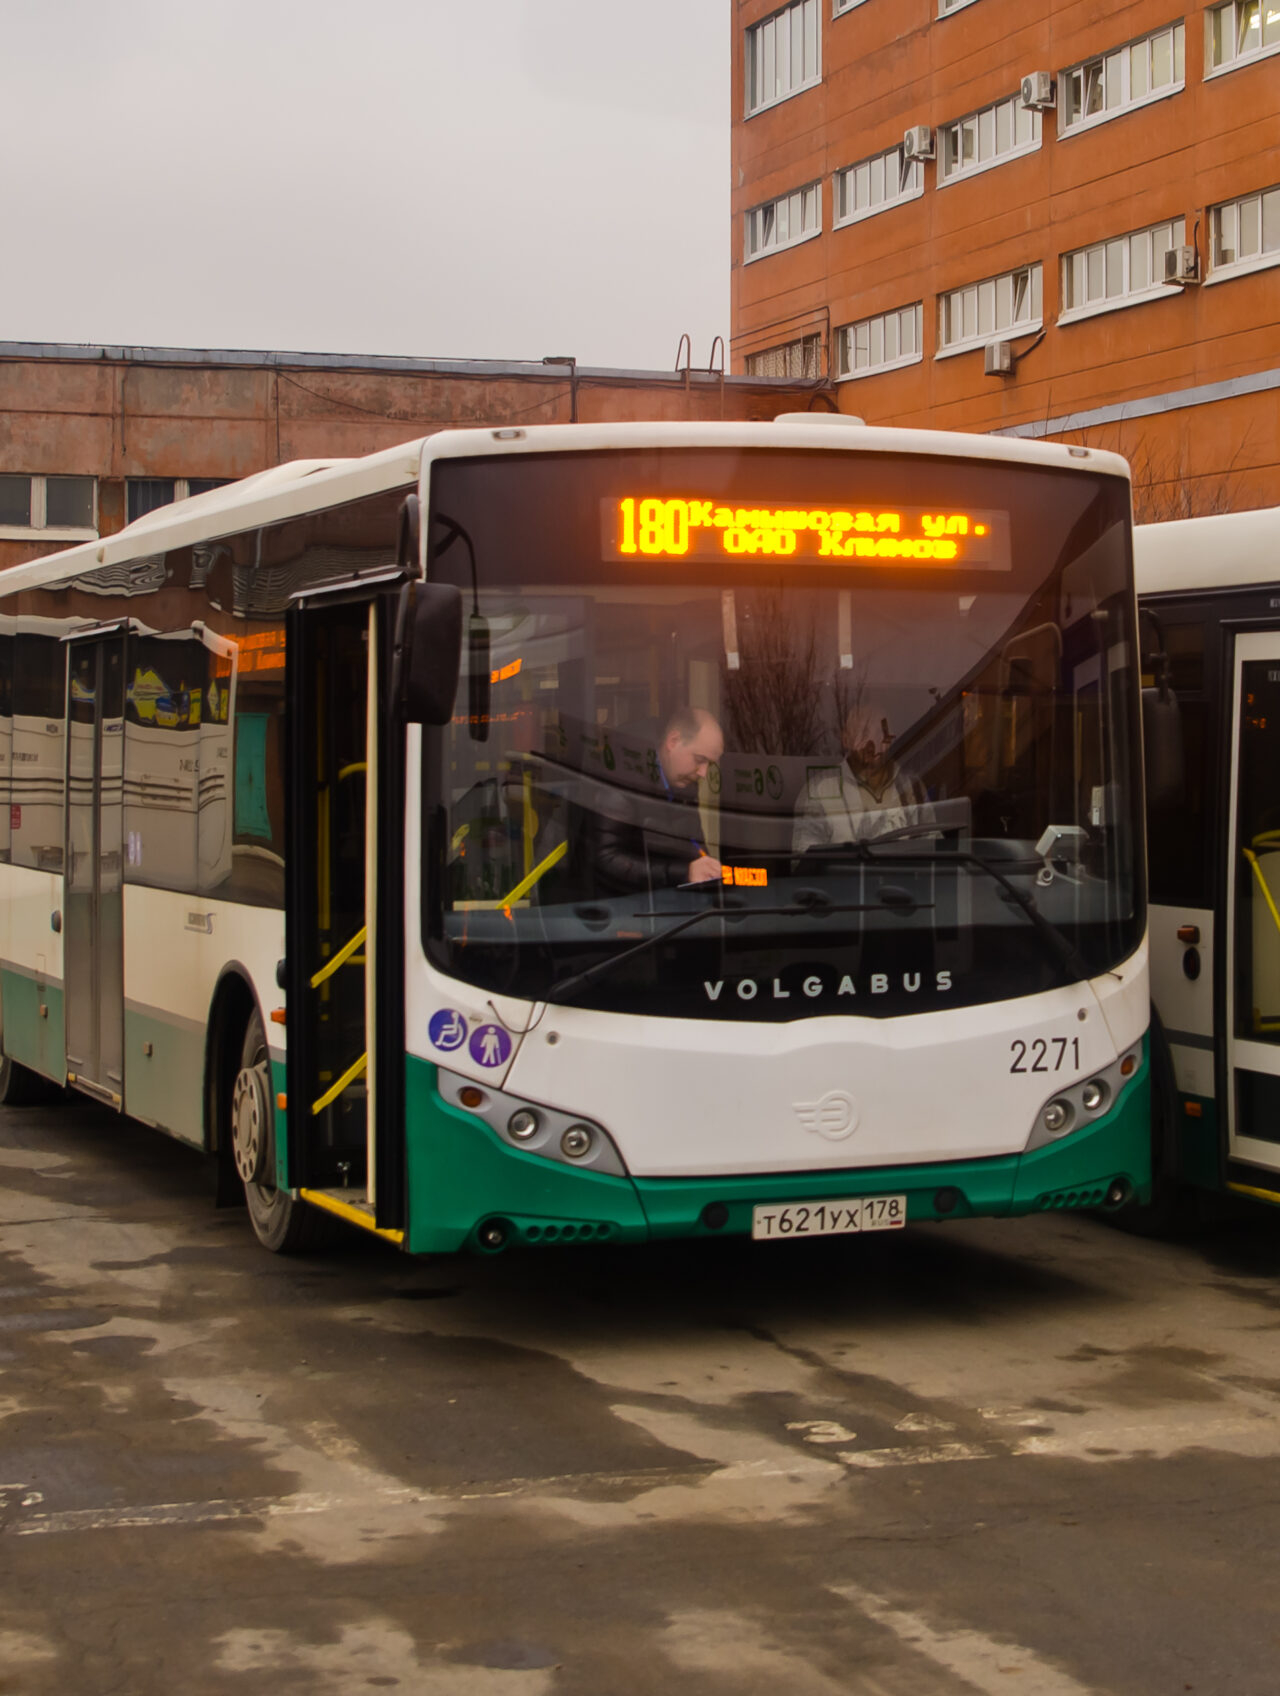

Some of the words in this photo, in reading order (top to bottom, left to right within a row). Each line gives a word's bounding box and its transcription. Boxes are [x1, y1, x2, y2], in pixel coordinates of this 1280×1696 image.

[620, 498, 689, 555] 180
[920, 513, 987, 537] ул.
[723, 528, 797, 555] ОАО
[818, 530, 958, 559] Климов
[704, 970, 953, 1001] VOLGABUS
[1009, 1036, 1080, 1073] 2271
[864, 1199, 899, 1219] 178
